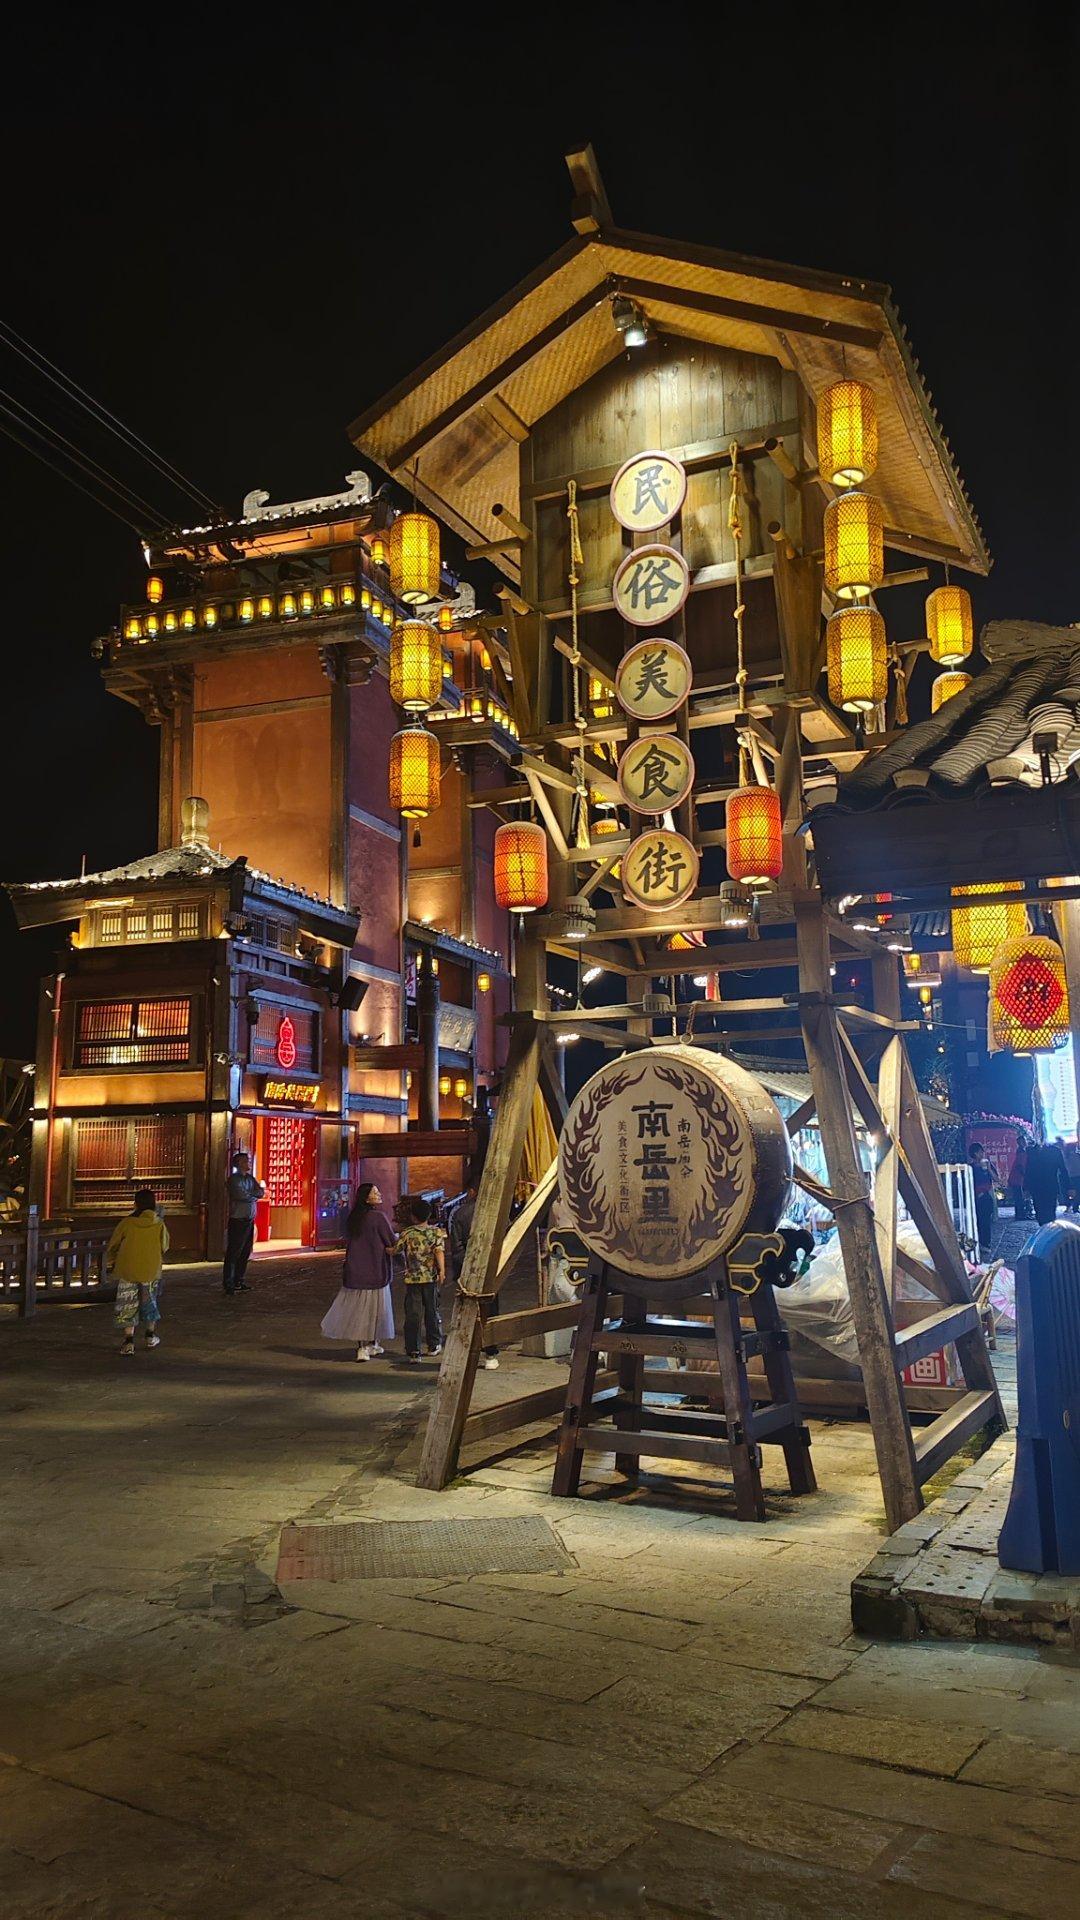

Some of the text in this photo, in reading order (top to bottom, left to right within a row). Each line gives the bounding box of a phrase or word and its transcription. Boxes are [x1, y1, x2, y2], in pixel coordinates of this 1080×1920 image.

[623, 463, 687, 894] 民俗美食街
[631, 1100, 679, 1224] 南岳里
